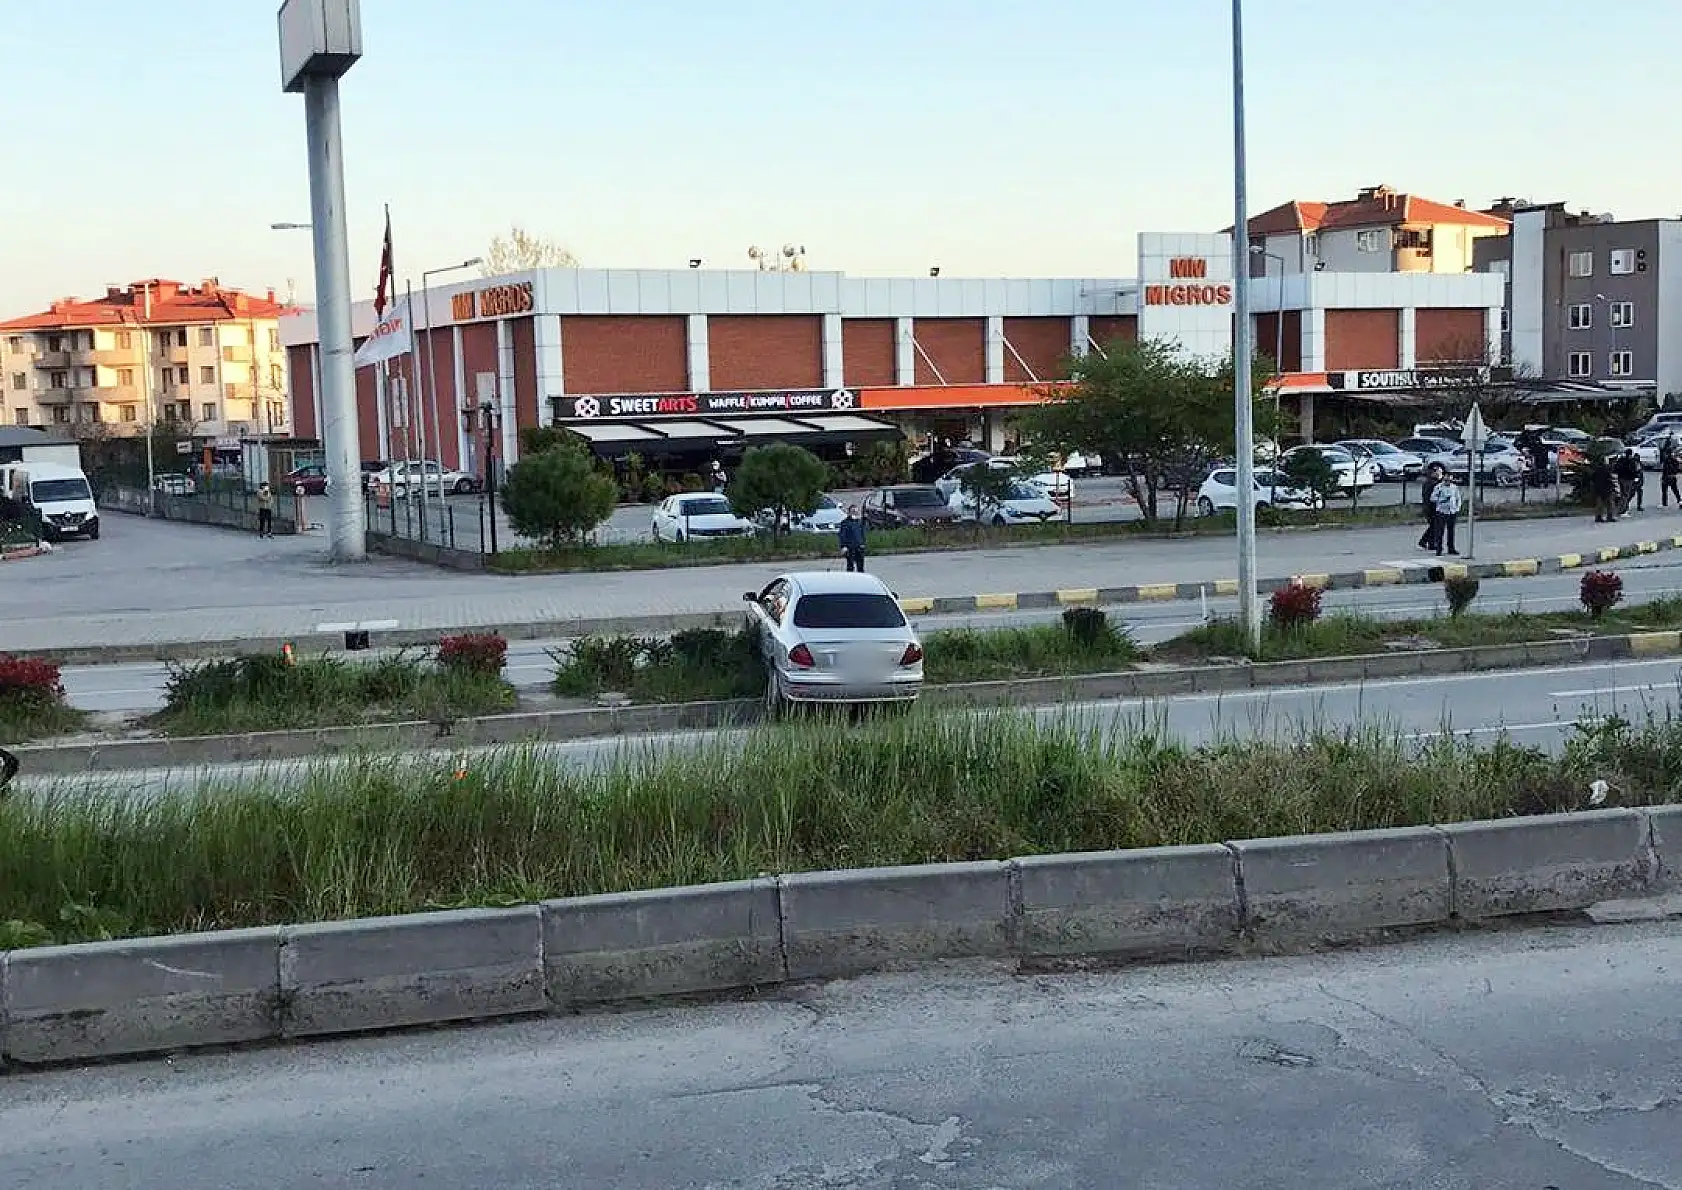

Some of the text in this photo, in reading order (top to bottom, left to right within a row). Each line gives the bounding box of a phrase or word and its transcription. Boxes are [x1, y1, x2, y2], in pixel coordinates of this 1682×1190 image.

[1169, 257, 1206, 279] MM
[451, 281, 535, 320] MM MIGROS
[1144, 284, 1233, 306] MIGROS
